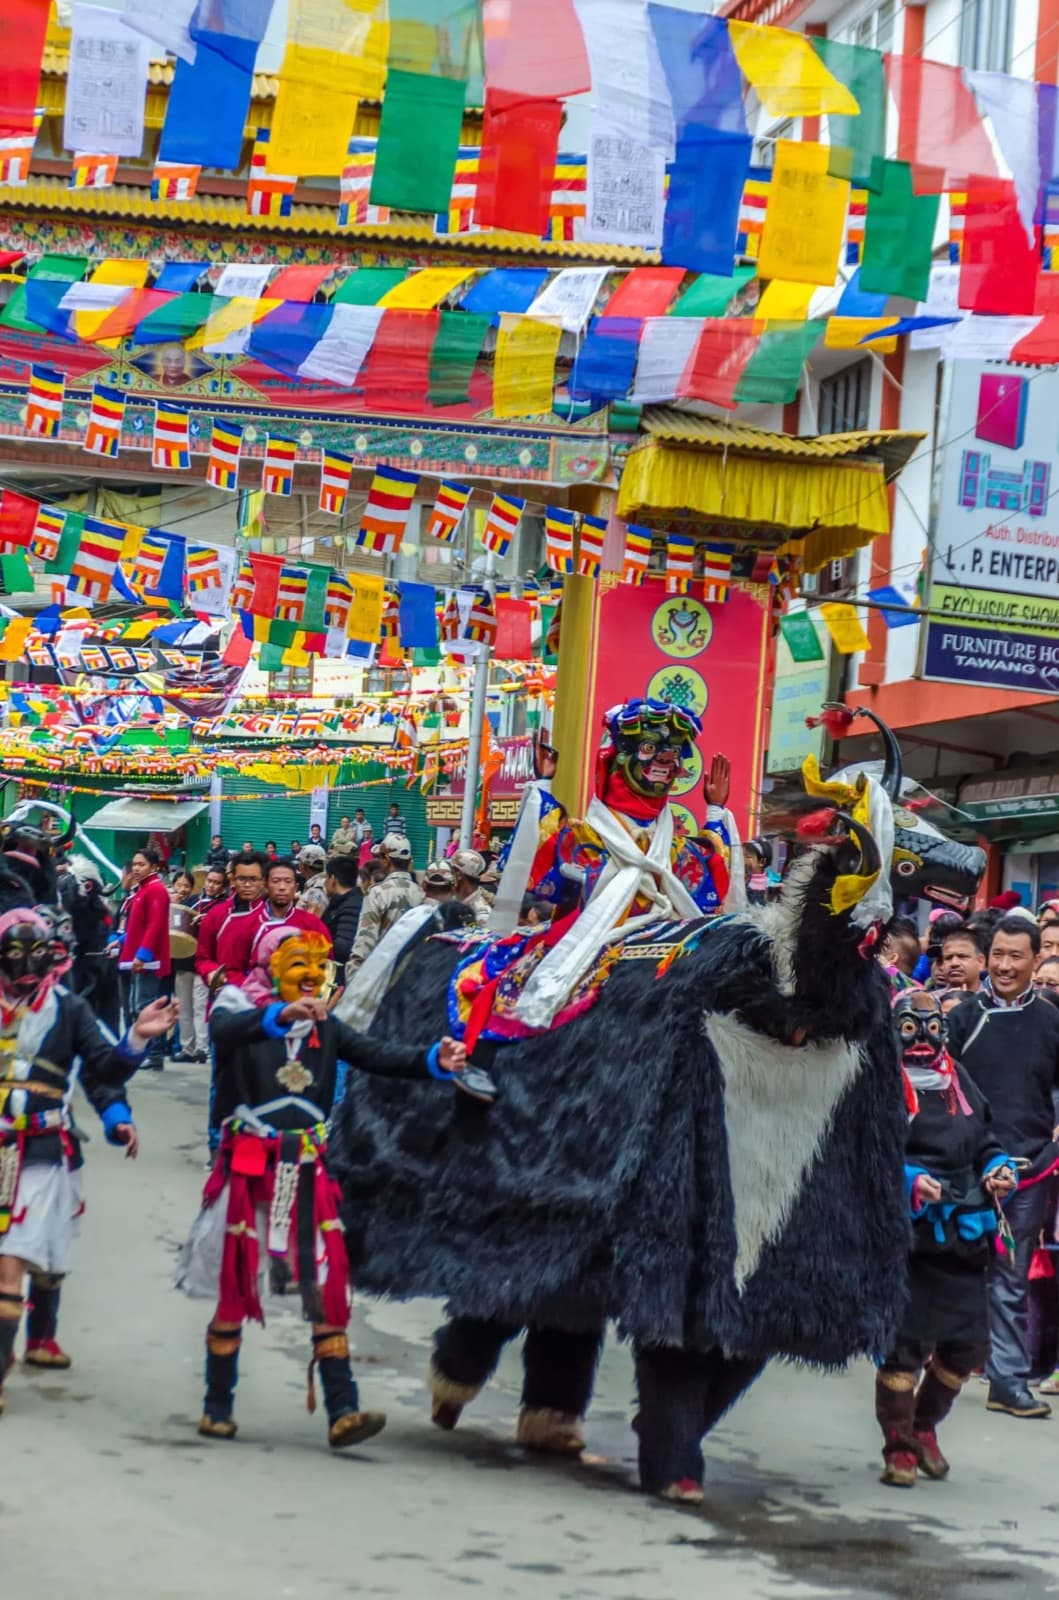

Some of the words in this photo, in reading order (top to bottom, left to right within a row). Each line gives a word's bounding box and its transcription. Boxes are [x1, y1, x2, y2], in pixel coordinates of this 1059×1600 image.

[990, 551, 1059, 584] ENTERP
[941, 633, 1037, 660] FURNITURE
[954, 655, 1036, 675] TAWANG
